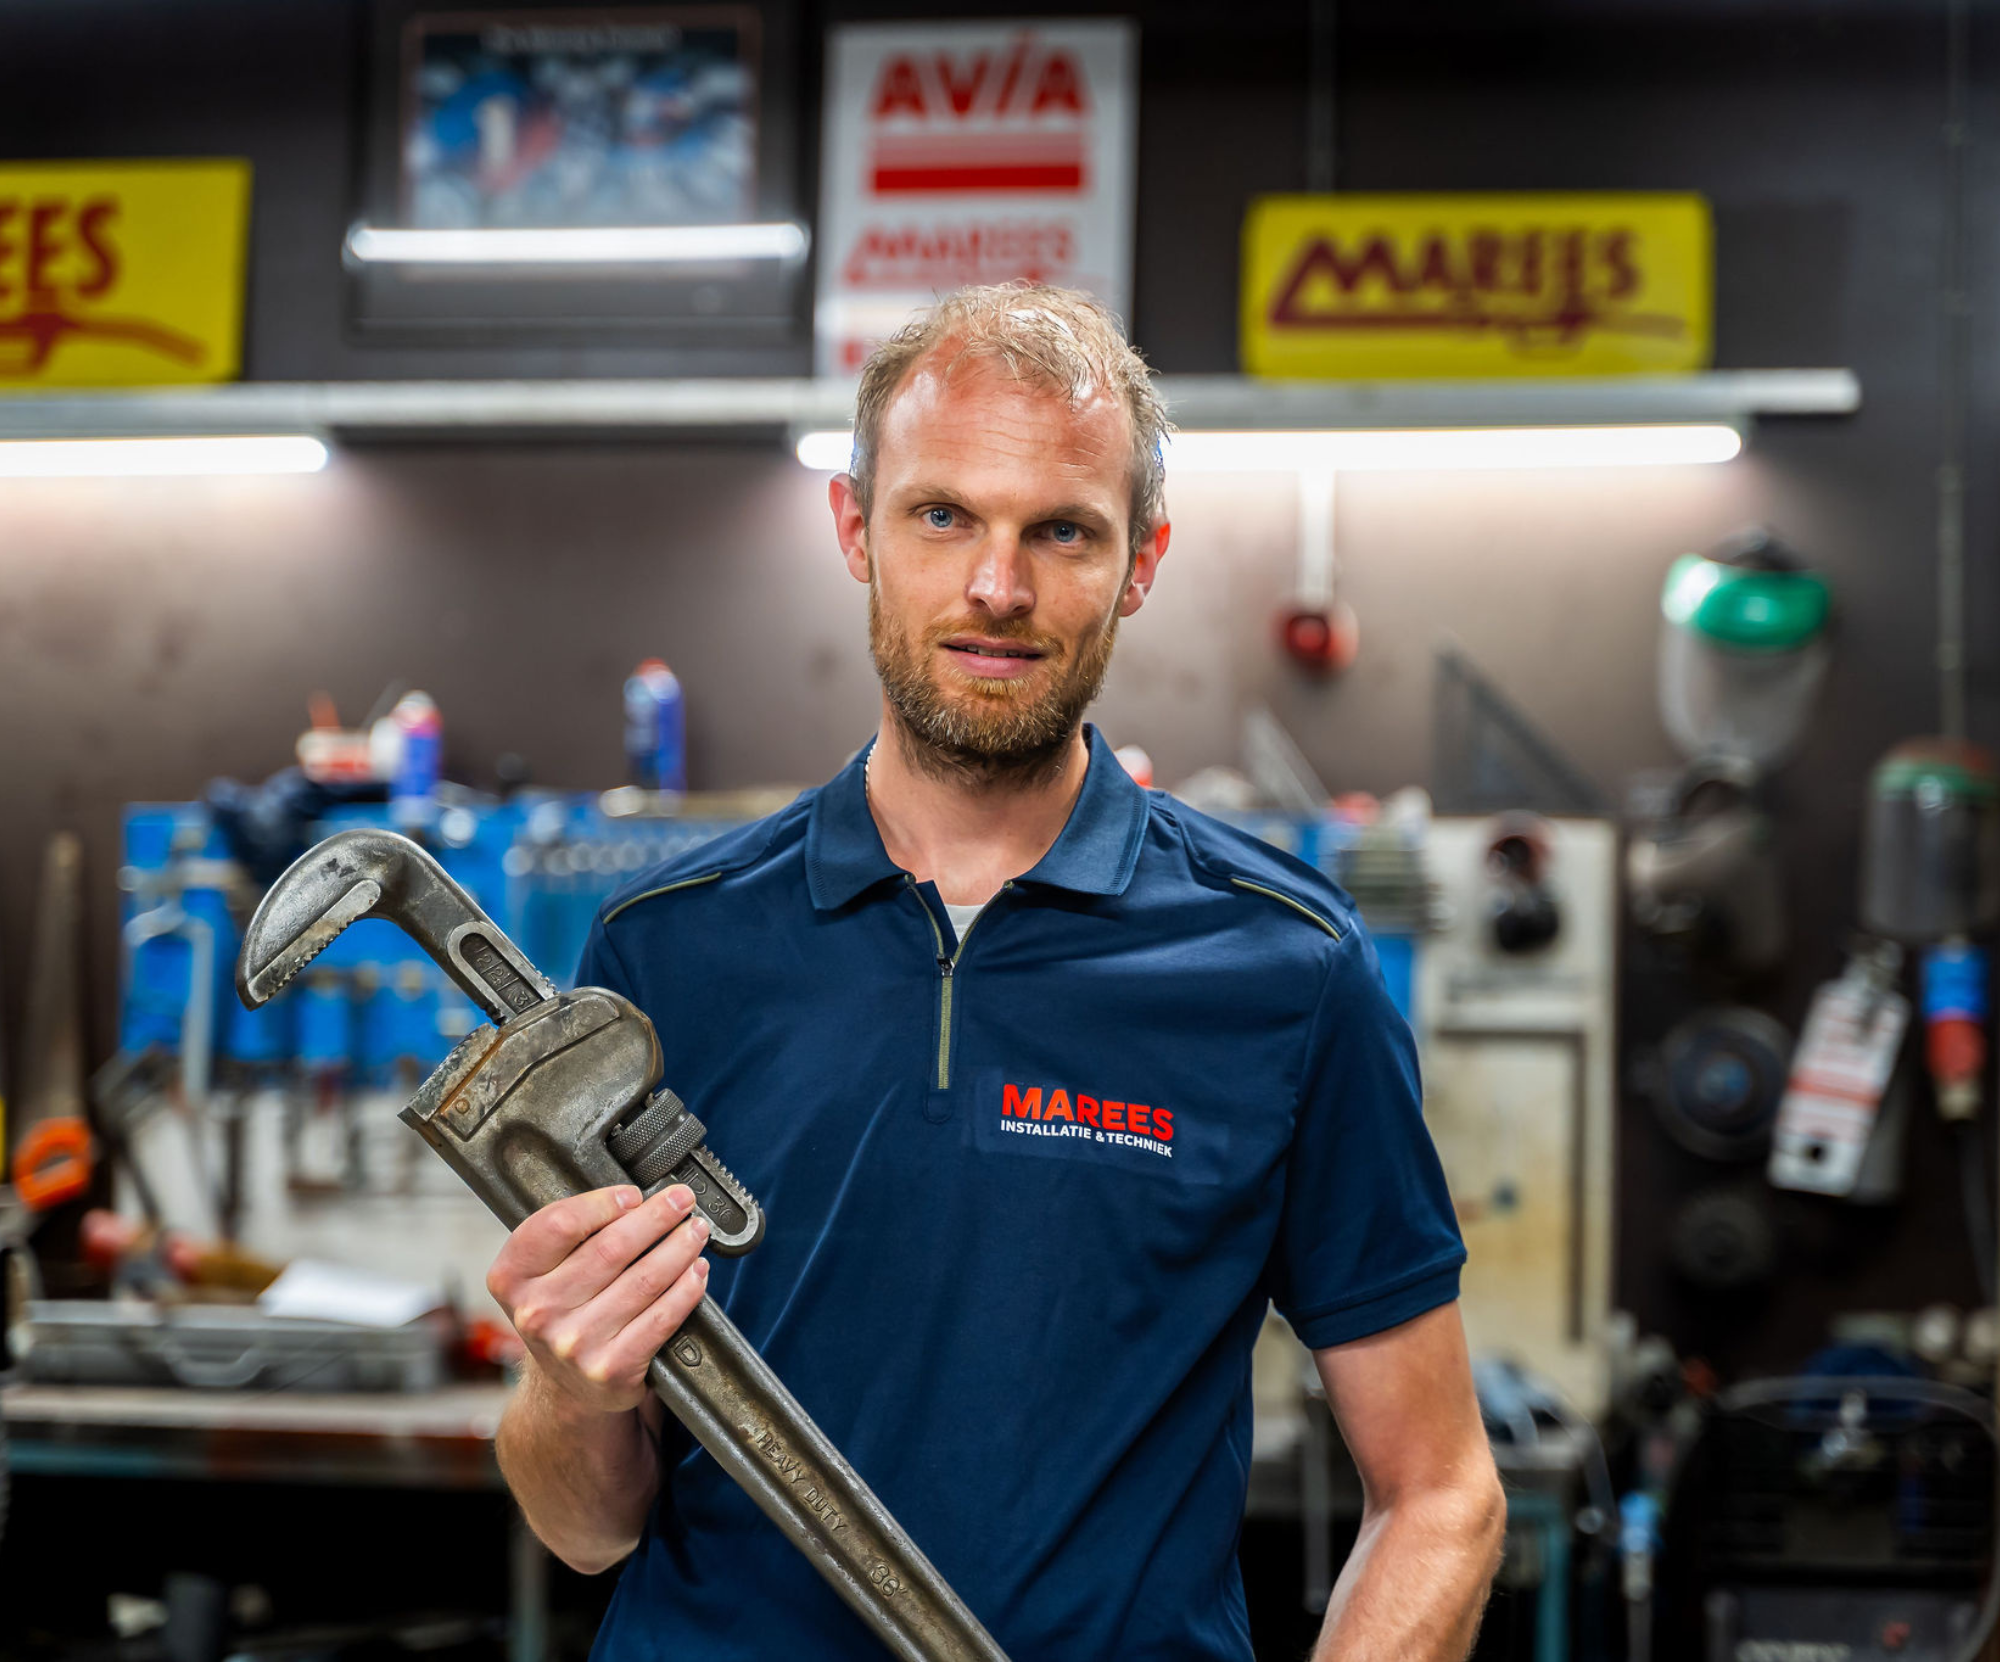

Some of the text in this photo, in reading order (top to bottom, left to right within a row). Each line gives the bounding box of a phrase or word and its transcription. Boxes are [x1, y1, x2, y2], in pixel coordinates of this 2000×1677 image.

[873, 34, 1090, 120] AVIA
[1001, 1119, 1173, 1158] INSTALLATIE & TECHNIEK
[1002, 1083, 1174, 1141] MAREES
[754, 1430, 806, 1484] HEAVY
[804, 1487, 848, 1532] DUTY
